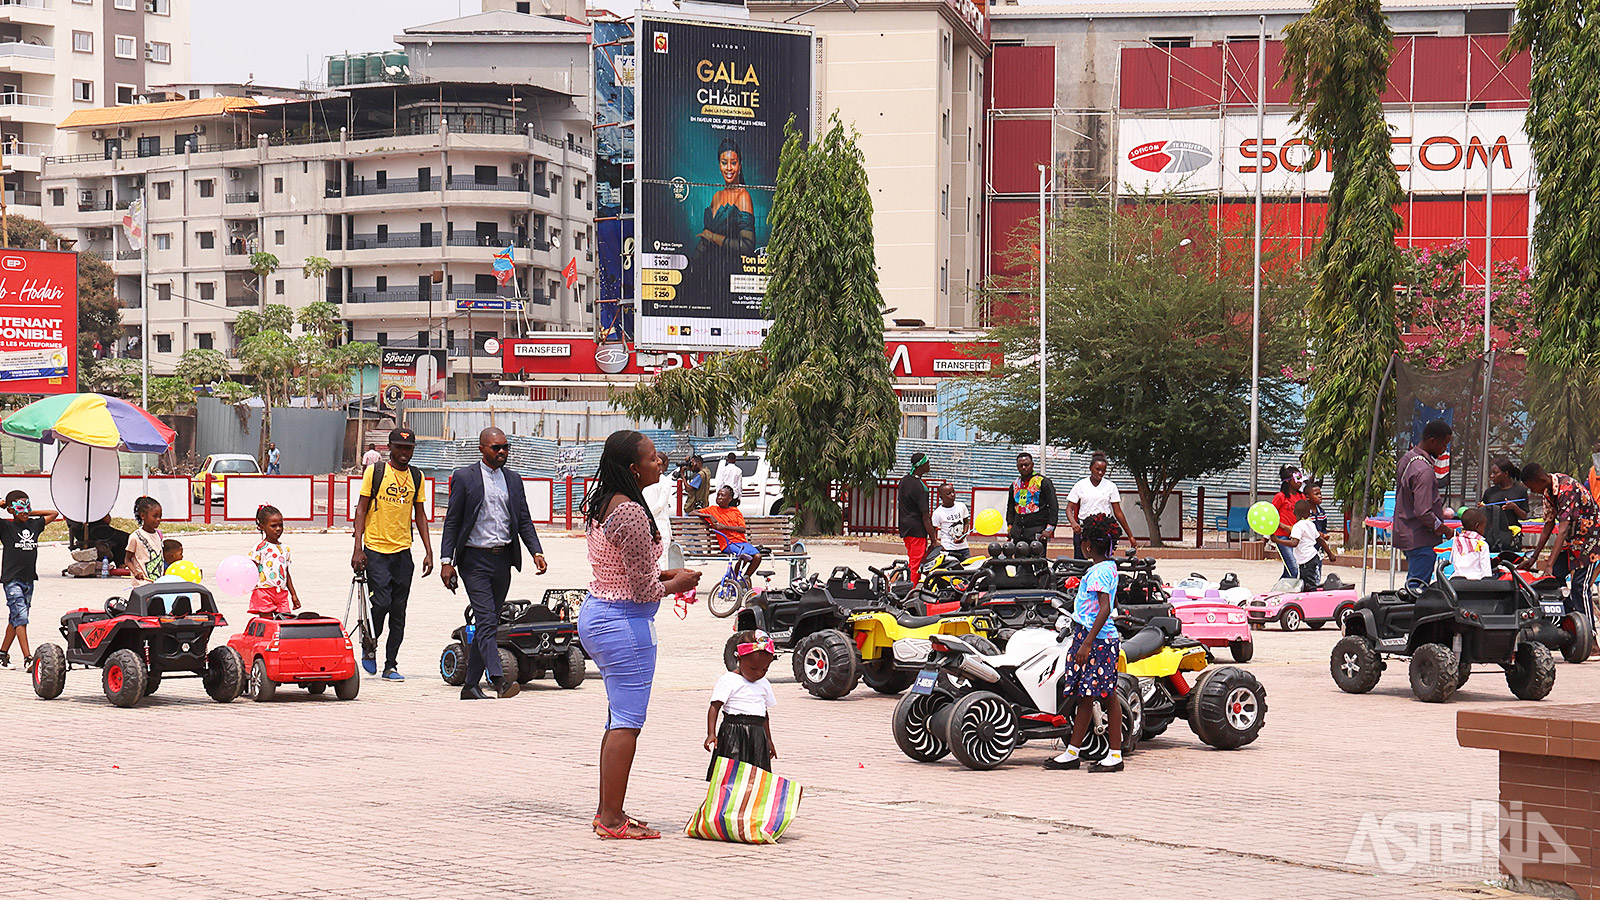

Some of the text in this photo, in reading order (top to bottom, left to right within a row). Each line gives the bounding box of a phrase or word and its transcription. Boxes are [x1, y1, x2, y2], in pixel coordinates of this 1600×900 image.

[697, 60, 760, 86] GALA
[696, 88, 760, 108] CHARITÉ
[741, 255, 756, 265] Ton
[742, 265, 757, 273] ton
[18, 278, 65, 302] Hodari
[0, 316, 63, 329] TENANT
[18, 341, 63, 349] PLATEFORMES
[516, 345, 569, 354] TRANSFERT
[384, 352, 416, 364] Special
[935, 361, 987, 370] TRANSFERT
